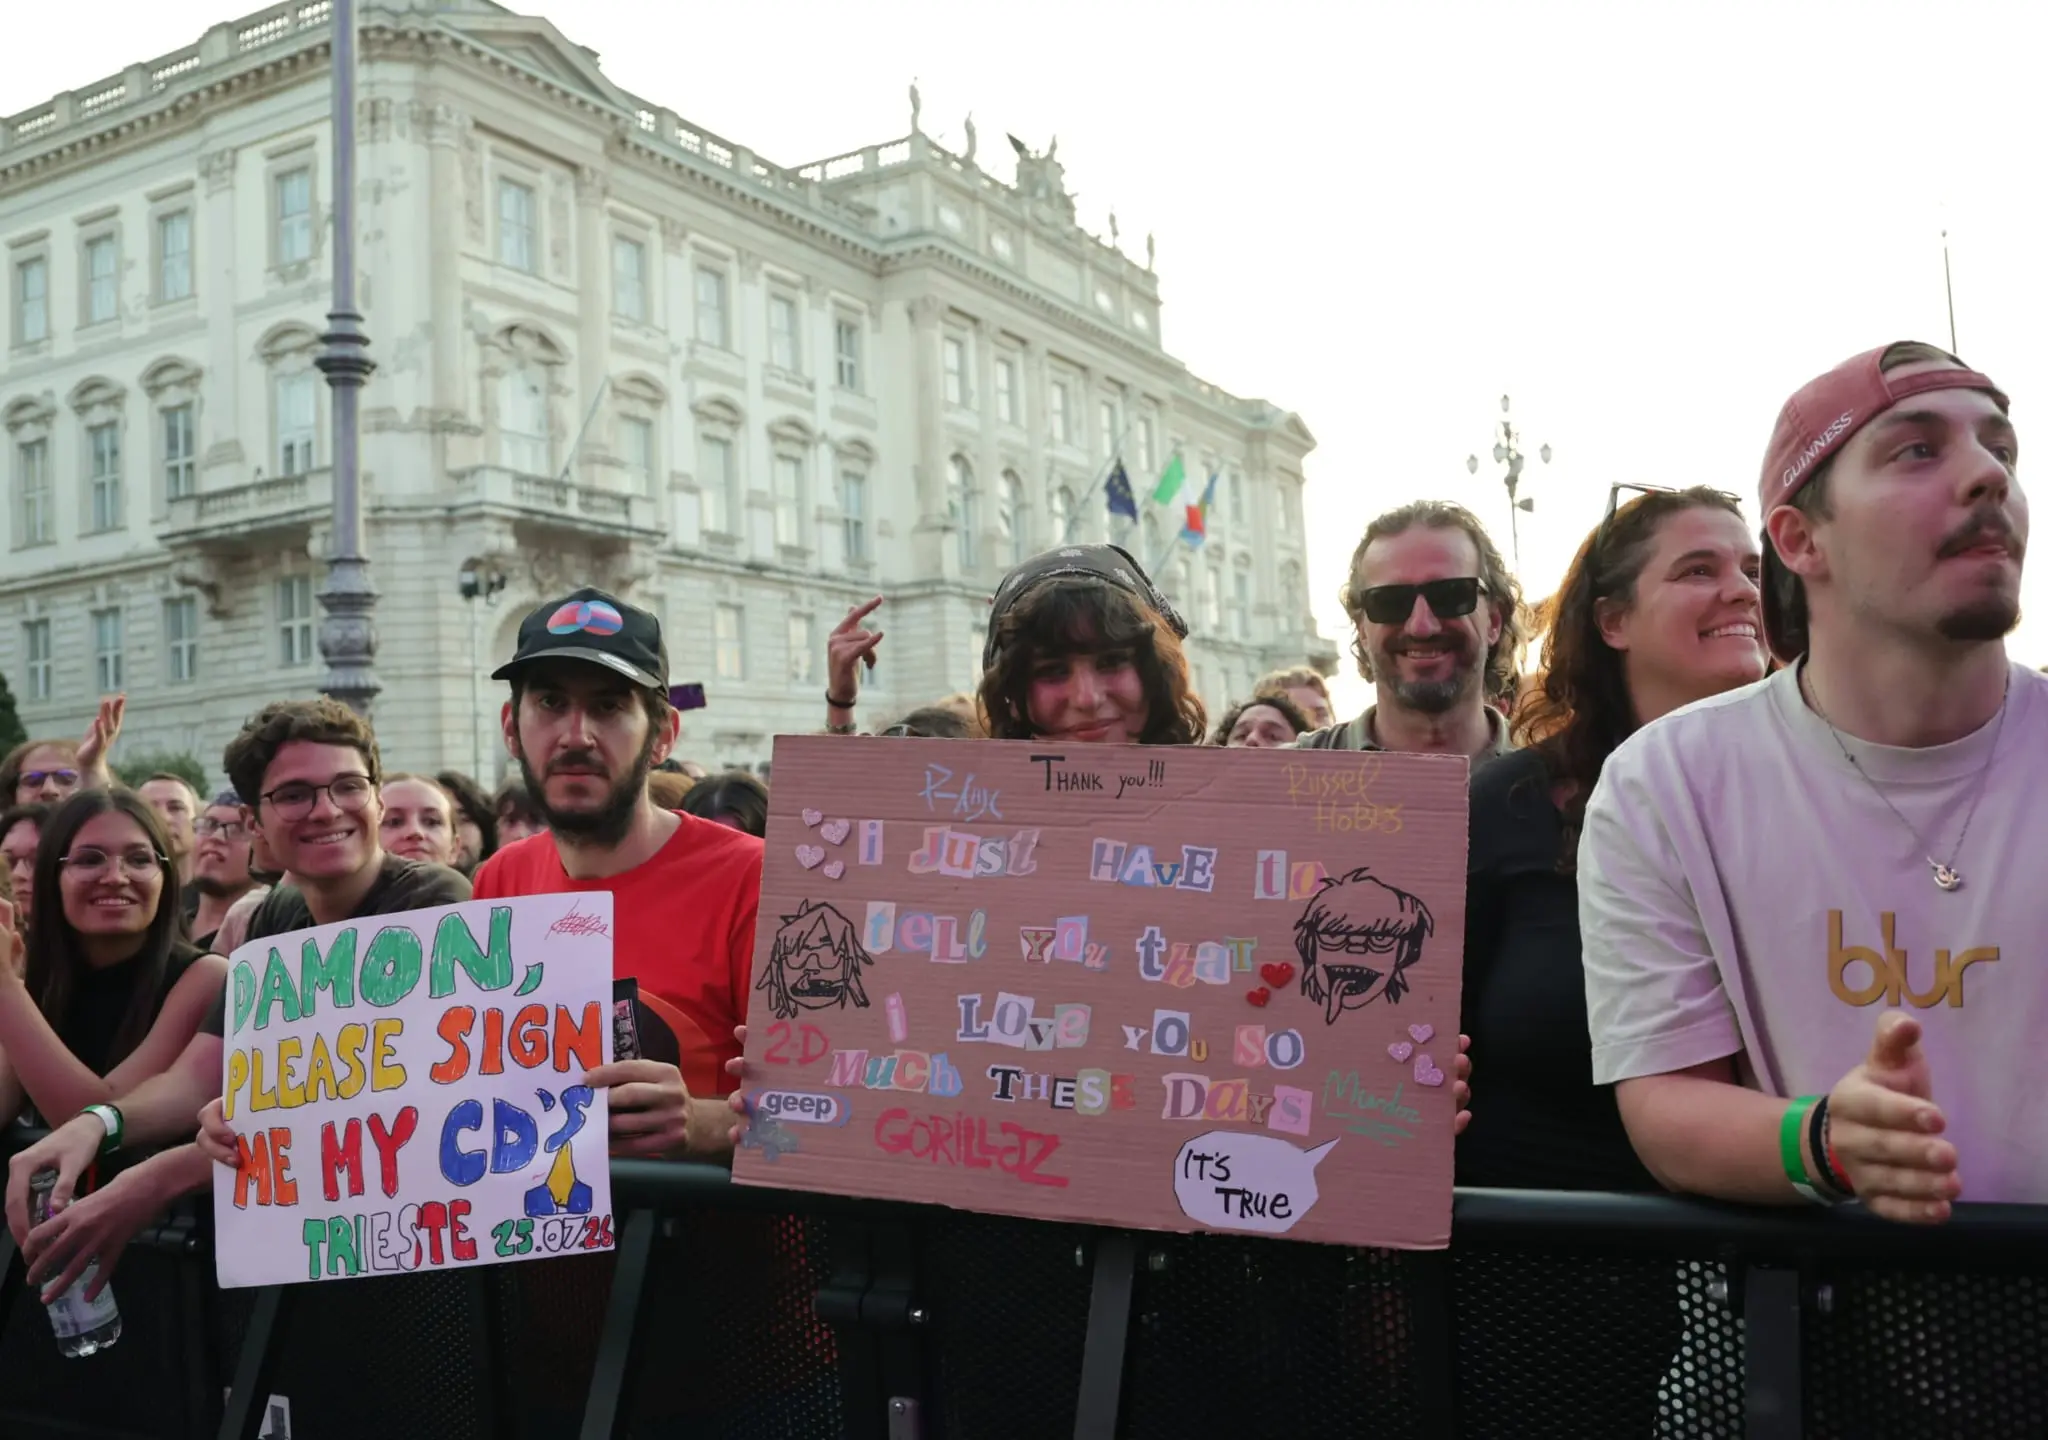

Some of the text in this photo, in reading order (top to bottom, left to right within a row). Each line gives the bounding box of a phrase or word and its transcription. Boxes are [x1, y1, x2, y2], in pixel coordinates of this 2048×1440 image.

[1783, 411, 1852, 487] GUINNESS
[233, 906, 543, 1036] DAMON,
[1827, 909, 2000, 1008] blur
[225, 1001, 603, 1121] PLEASE SIGN
[762, 1093, 832, 1119] geep
[234, 1085, 594, 1209] ME MY CD'S
[303, 1200, 477, 1279] TRIESTE
